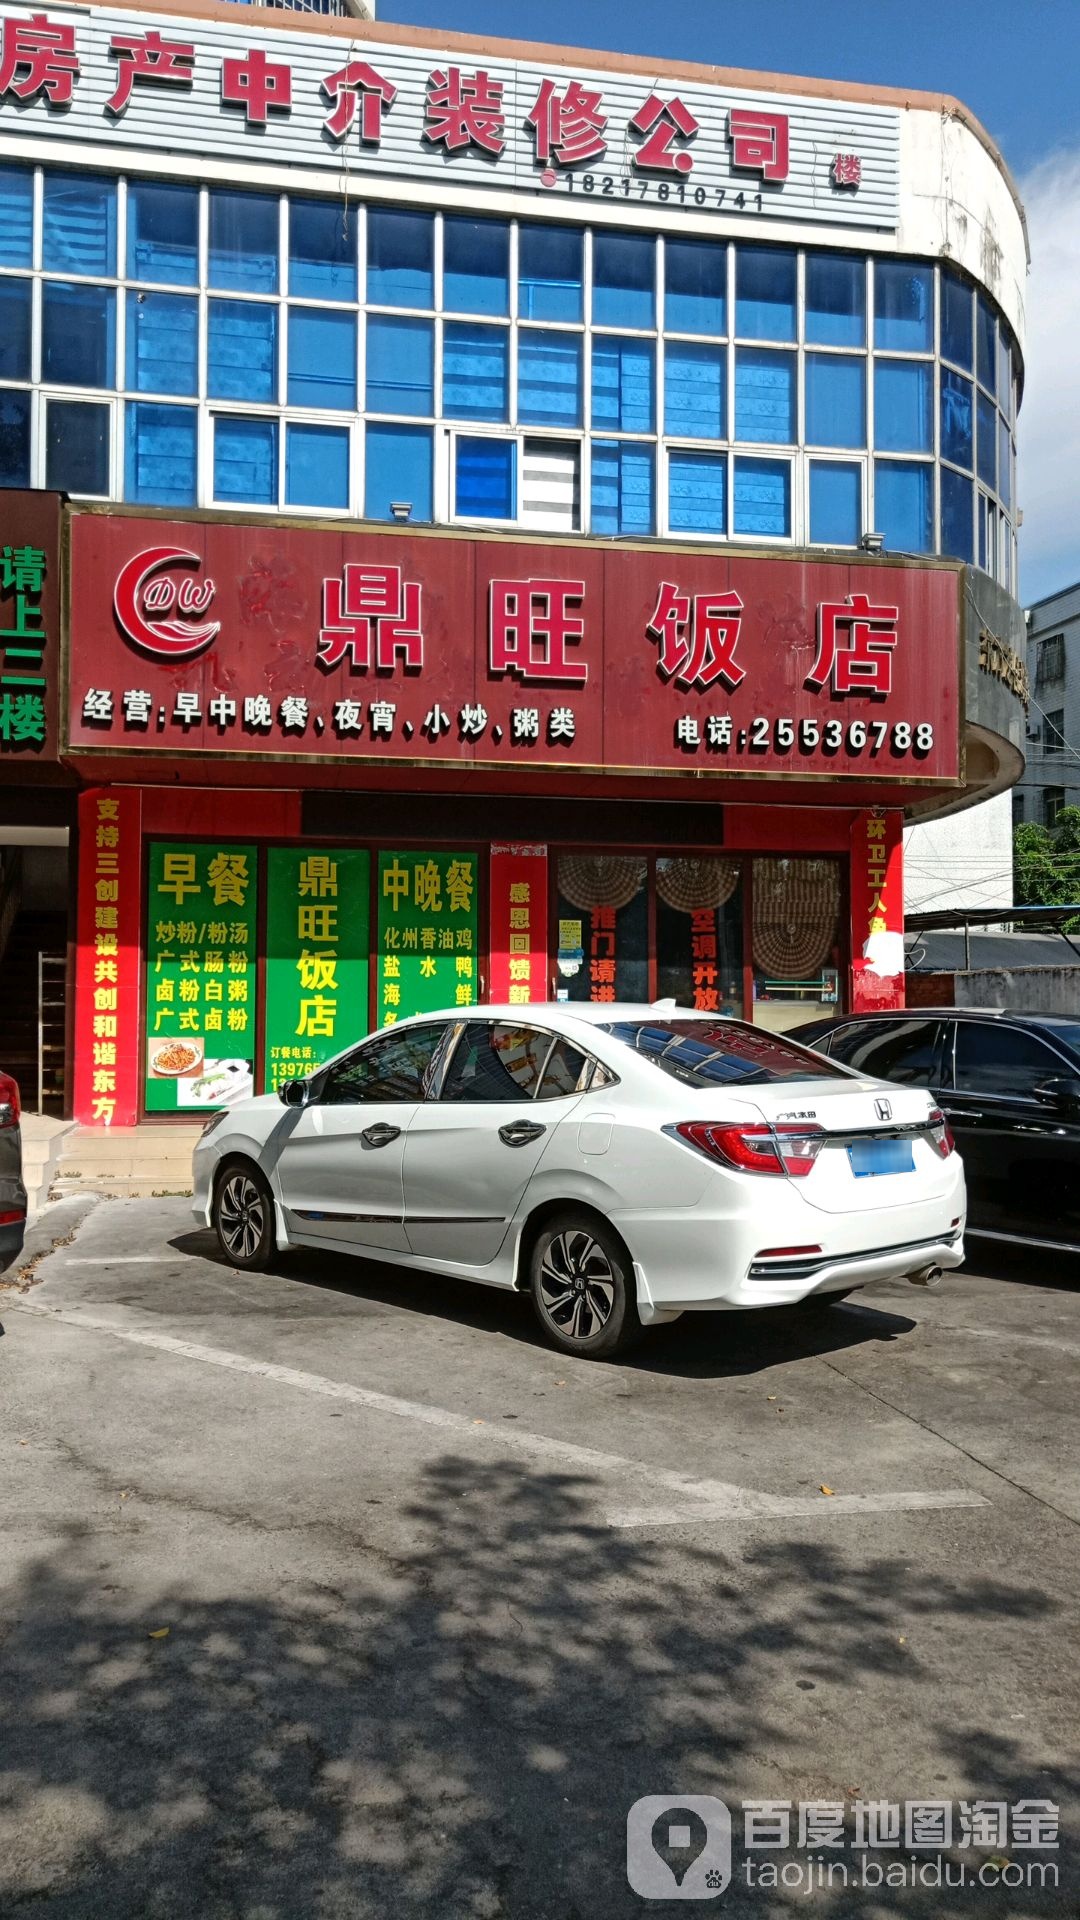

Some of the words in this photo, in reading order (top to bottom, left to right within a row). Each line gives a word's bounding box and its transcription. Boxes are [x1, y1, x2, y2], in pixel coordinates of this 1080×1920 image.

[0, 13, 790, 183] 房产中介装修公司
[833, 153, 862, 187] 楼
[564, 173, 763, 212] 18217810741
[0, 546, 46, 741] 请上二楼
[318, 563, 899, 694] 鼎旺饭店
[677, 715, 934, 752] 电话:25536788
[158, 852, 249, 906] 早餐
[383, 859, 473, 912] 中晚餐
[156, 922, 249, 945] 炒粉/粉汤
[296, 856, 339, 1037] 鼎旺饭店
[384, 927, 473, 950] 化州香油鸡
[92, 799, 120, 1124] 支持三创建设共创和谐东方
[155, 951, 248, 974] 广式肠粉
[384, 956, 472, 978] 盐水鸭
[590, 905, 616, 1002] 推门请进
[691, 908, 718, 1010] 空调开放
[156, 979, 248, 1002] 卤粉白粥
[384, 983, 472, 1006] 海鲜
[154, 1008, 248, 1031] 广式卤粉
[776, 1111, 816, 1120] 广汽本田
